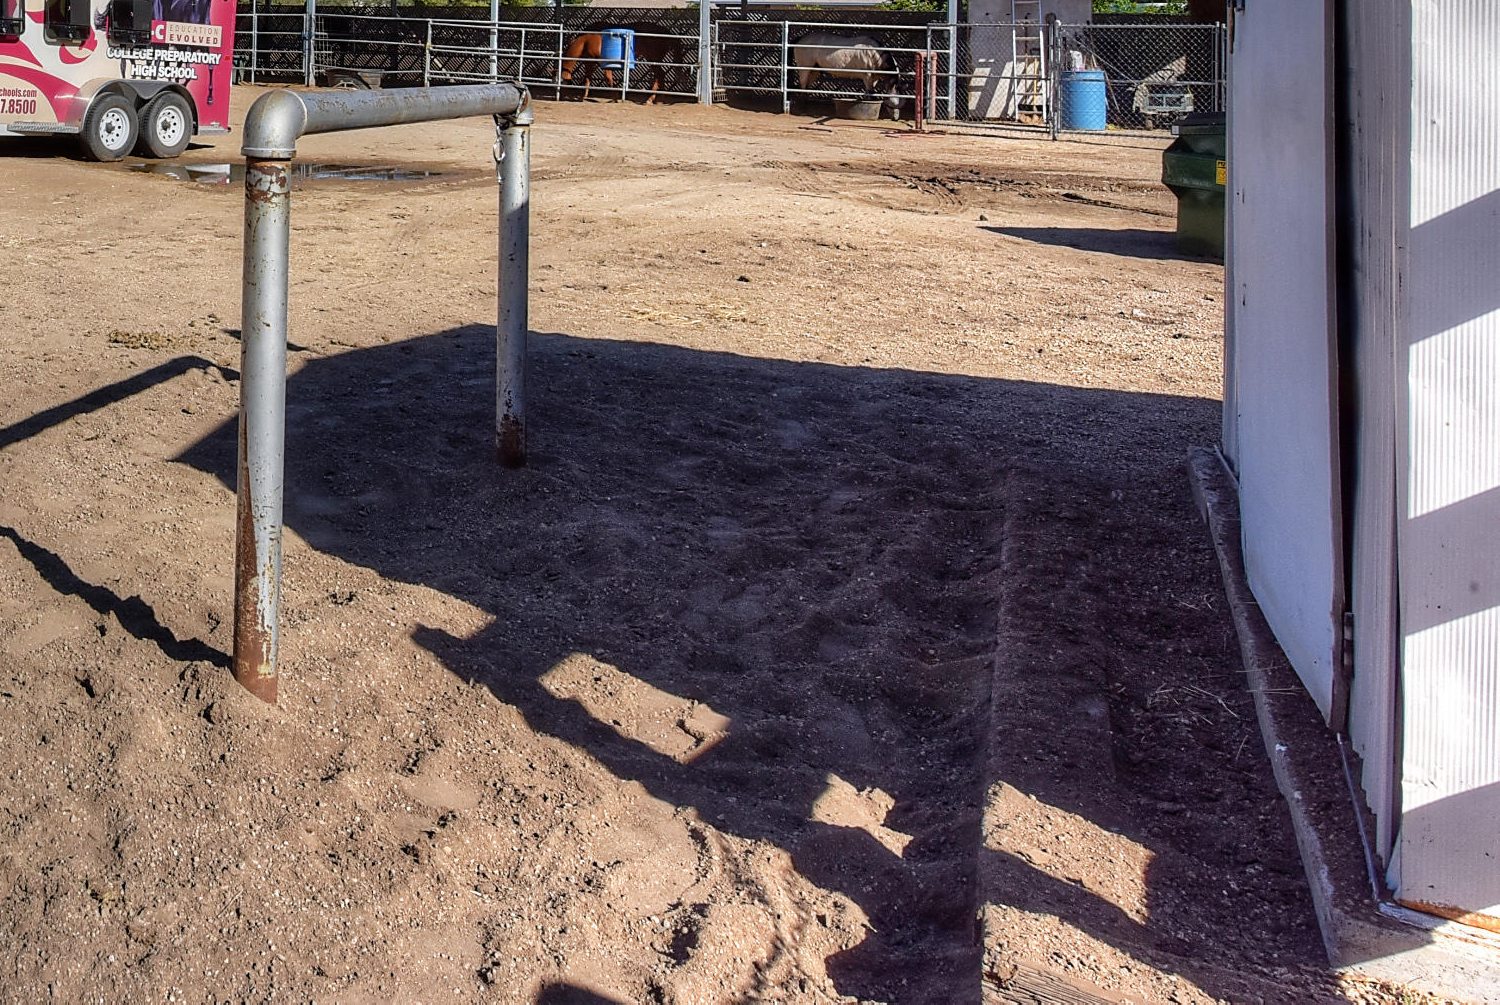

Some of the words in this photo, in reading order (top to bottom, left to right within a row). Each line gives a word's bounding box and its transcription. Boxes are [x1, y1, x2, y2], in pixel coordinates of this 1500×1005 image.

[151, 24, 165, 40] C
[169, 24, 219, 35] EDUCATION
[169, 34, 219, 45] EVOLVED
[106, 47, 154, 60] COLLEGE
[154, 49, 222, 65] PREPARATORY
[131, 63, 157, 78] HIGH
[158, 66, 198, 79] SCHOOL
